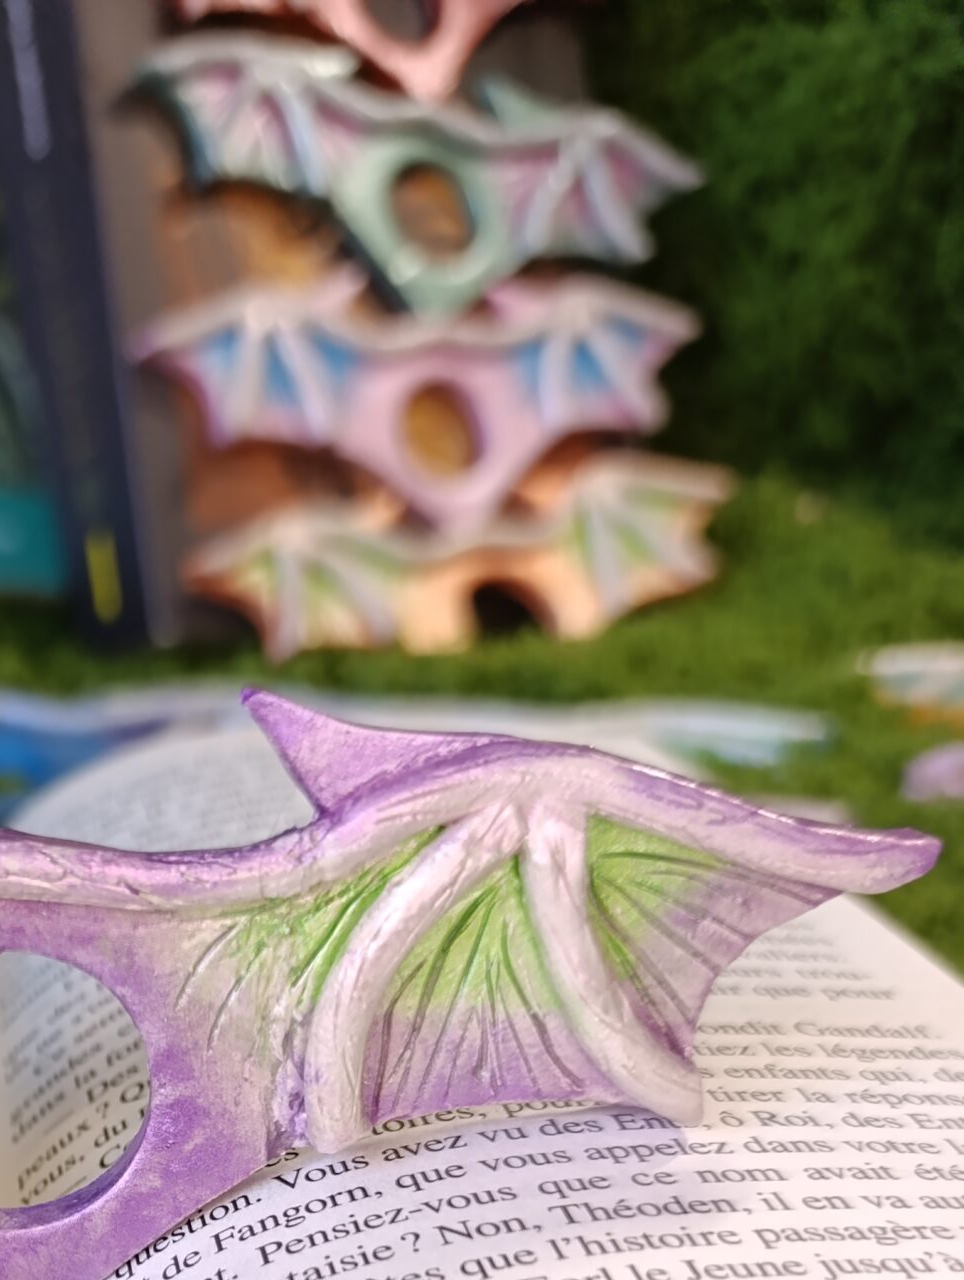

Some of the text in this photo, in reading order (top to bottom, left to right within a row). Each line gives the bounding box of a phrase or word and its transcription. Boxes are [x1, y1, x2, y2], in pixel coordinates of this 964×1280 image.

[760, 1041, 813, 1058] les
[793, 1020, 942, 1040] Gandalf.
[705, 1086, 836, 1104] tirer la
[723, 1061, 929, 1086] enfants qui,
[17, 1117, 91, 1192] peaux
[93, 1119, 129, 1150] du
[273, 1109, 904, 1190] Vous avez vu des ô Roi, des
[210, 1182, 384, 1255] Fangorn,
[394, 1163, 468, 1193] que
[478, 1148, 573, 1172] vous
[583, 1137, 735, 1164] appelez
[742, 1136, 835, 1154] dans
[842, 1138, 941, 1155] votre
[255, 1183, 518, 1268] Pensiez-vous
[537, 1174, 613, 1200] que
[630, 1169, 678, 1187] ce
[694, 1166, 789, 1184] nom
[802, 1162, 901, 1182] avait
[433, 1215, 543, 1247] Non,
[547, 1195, 753, 1226] Théoden,
[754, 1191, 796, 1212] il
[801, 1194, 855, 1211] en
[858, 1194, 912, 1209] va
[460, 1248, 539, 1280] que
[548, 1226, 744, 1262] l'histoire
[753, 1218, 957, 1251] passagère
